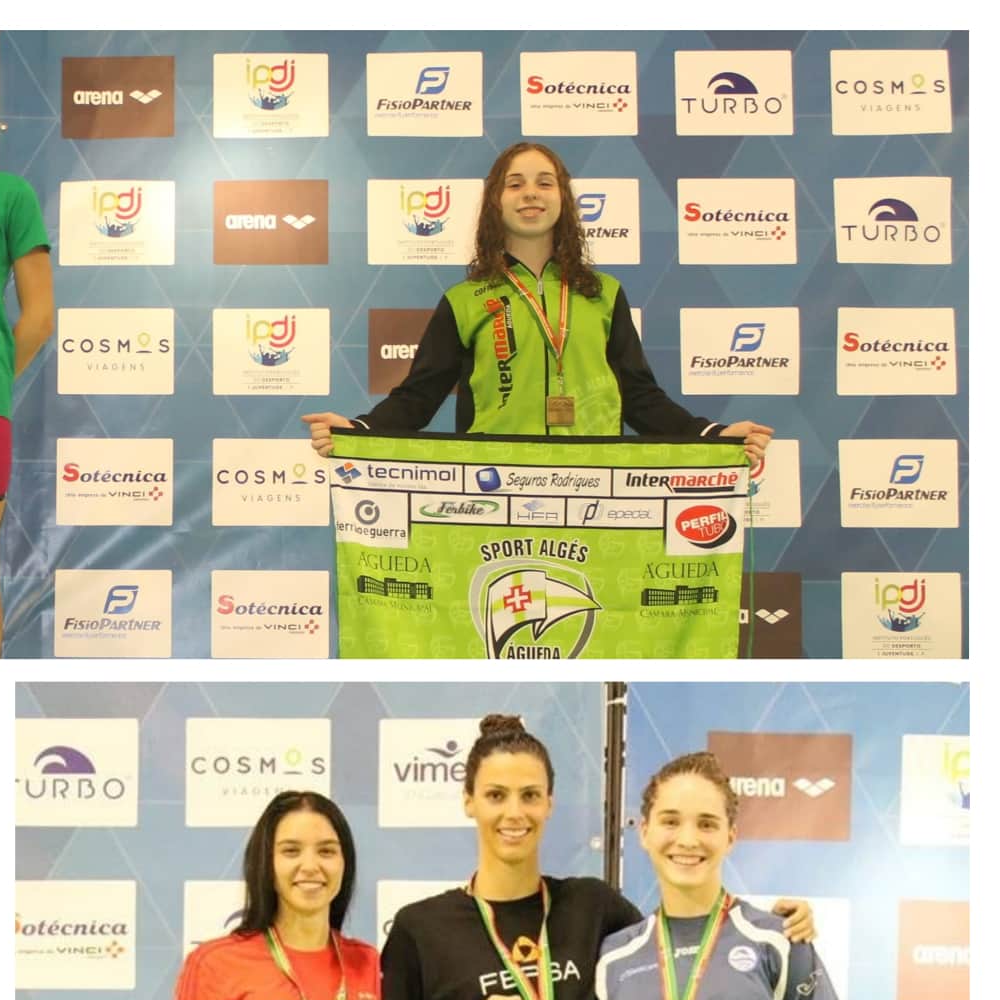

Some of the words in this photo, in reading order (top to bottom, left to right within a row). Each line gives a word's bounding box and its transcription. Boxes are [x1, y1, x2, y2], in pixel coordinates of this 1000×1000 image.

[247, 59, 295, 93] ipdj
[527, 76, 632, 95] Sotécnica
[73, 90, 123, 105] arena
[682, 97, 782, 114] TURBO
[402, 186, 450, 219] ipdj
[684, 203, 790, 222] Sotécnica
[225, 215, 276, 230] arena
[842, 225, 940, 243] TURBO
[843, 332, 950, 353] Sotécnica
[62, 463, 166, 483] Sotécnica
[368, 464, 456, 482] tecnimol
[506, 472, 547, 490] Seguros
[550, 472, 600, 492] Rodrigues
[626, 472, 738, 492] Intermarché
[109, 490, 145, 498] VINCI
[241, 494, 300, 503] VIAGENS
[681, 511, 729, 532] PERFIL
[480, 539, 534, 562] SPORT
[539, 539, 588, 563] ALGÉS
[217, 596, 322, 616] Sotécnica
[875, 578, 926, 614] ipdj
[264, 623, 301, 631] VINCI
[395, 761, 467, 783] vime
[16, 778, 125, 799] URBO
